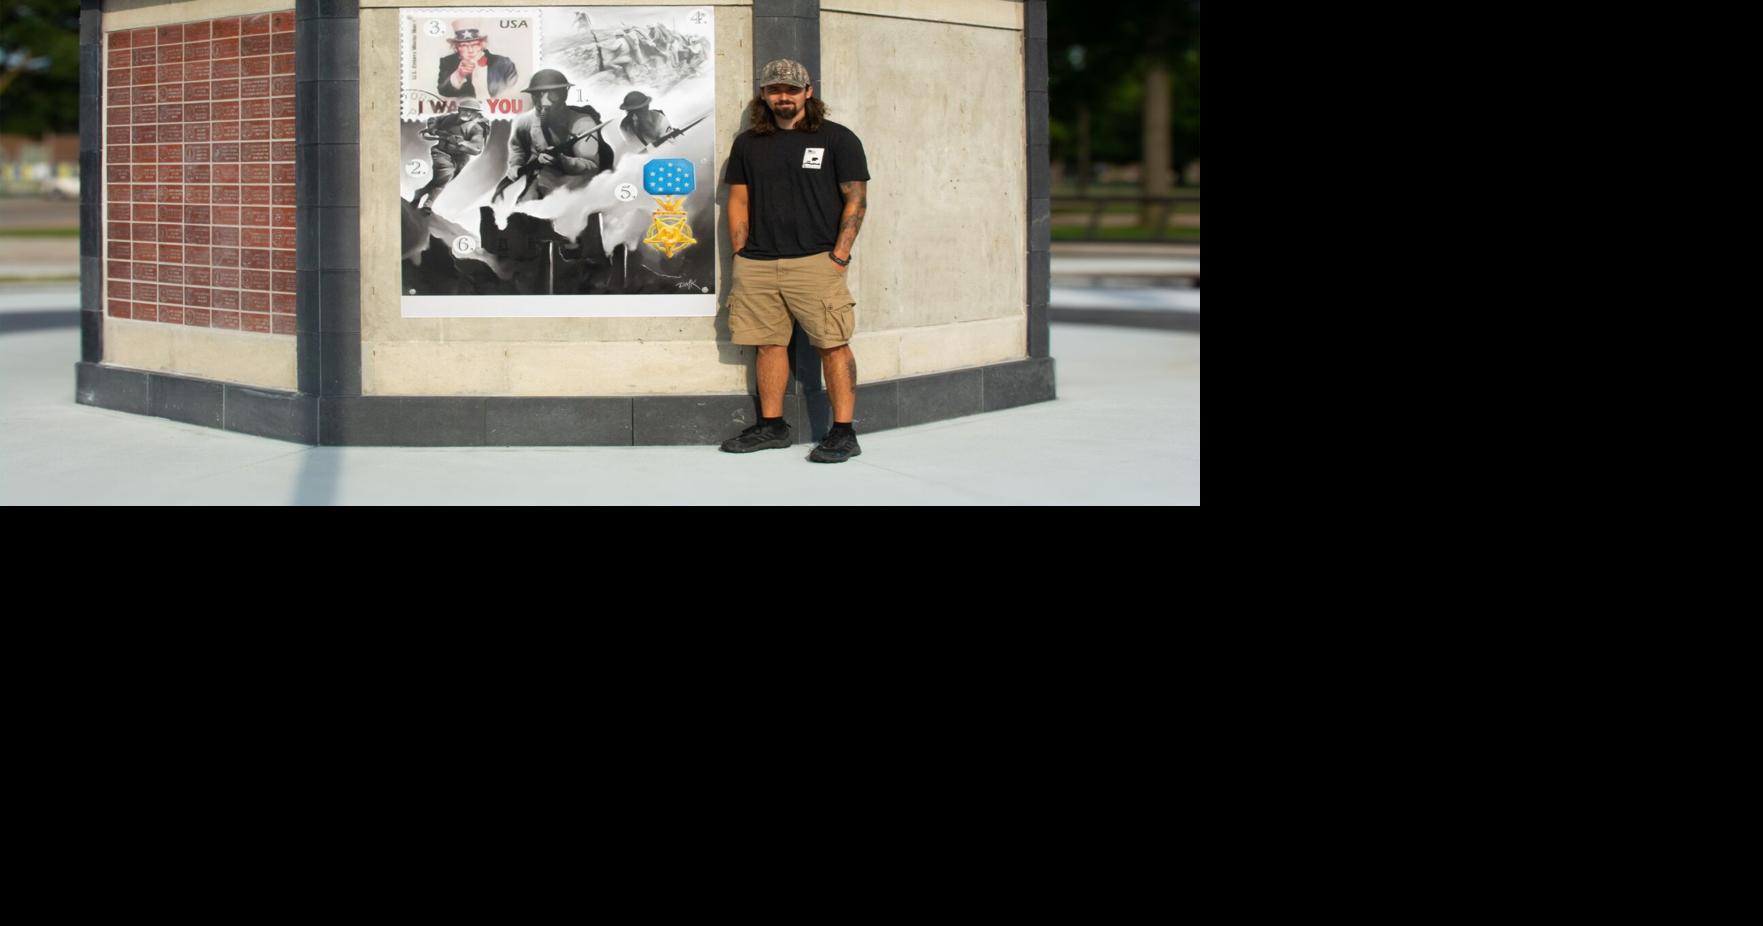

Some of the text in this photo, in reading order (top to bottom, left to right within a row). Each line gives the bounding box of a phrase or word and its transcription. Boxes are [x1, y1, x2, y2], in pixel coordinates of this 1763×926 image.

[690, 11, 708, 24] 4.
[430, 21, 445, 34] 3.
[500, 20, 528, 29] USA
[576, 89, 589, 102] 1.
[418, 101, 423, 114] I
[487, 99, 523, 114] YOU
[407, 162, 426, 175] 2.
[620, 185, 636, 199] 5.
[458, 237, 475, 252] 6.
